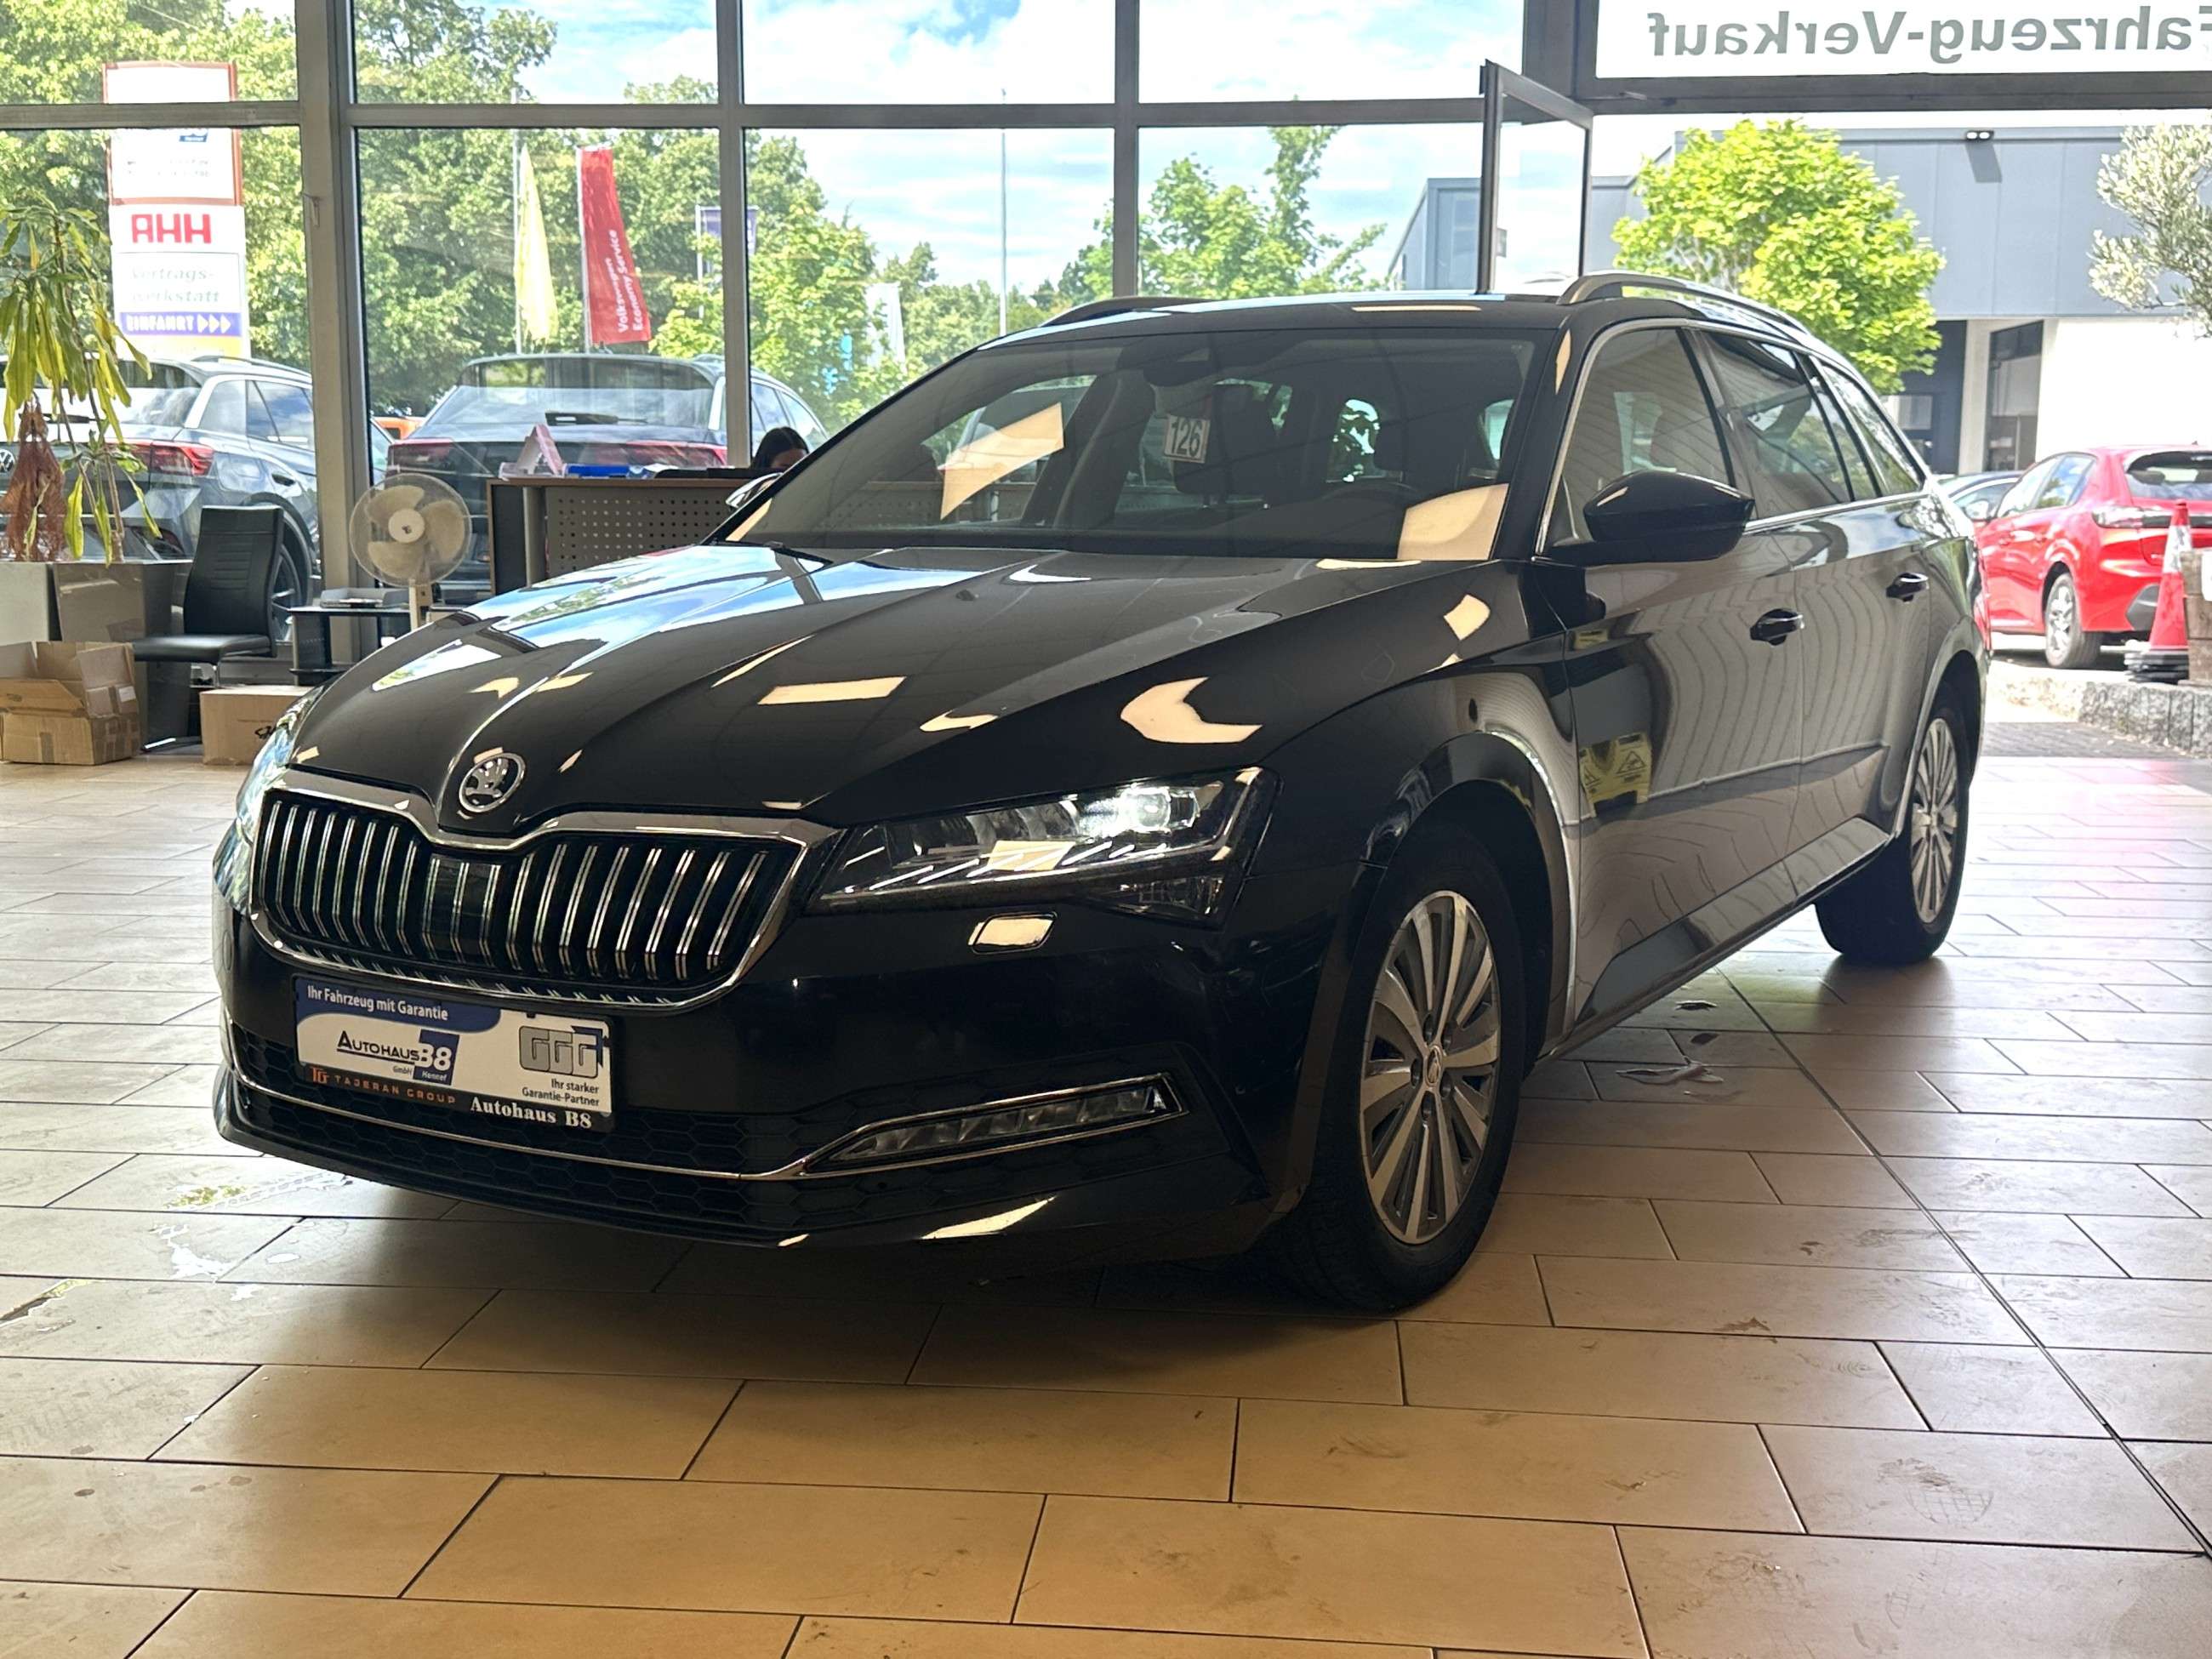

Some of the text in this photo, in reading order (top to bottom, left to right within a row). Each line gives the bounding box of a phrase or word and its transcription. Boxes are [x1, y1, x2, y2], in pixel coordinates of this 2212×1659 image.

[131, 213, 212, 244] AHH
[605, 257, 629, 333] Volkswagen
[608, 229, 644, 332] Economy Service
[1171, 417, 1203, 458] 126
[307, 985, 448, 1021] Ihr Fahrzeug mit Garantie
[406, 1088, 456, 1104] GROUP
[522, 1086, 600, 1106] Garantie-Partner
[551, 1078, 599, 1094] Ihr starker
[470, 1096, 592, 1129] Autohaus B8
